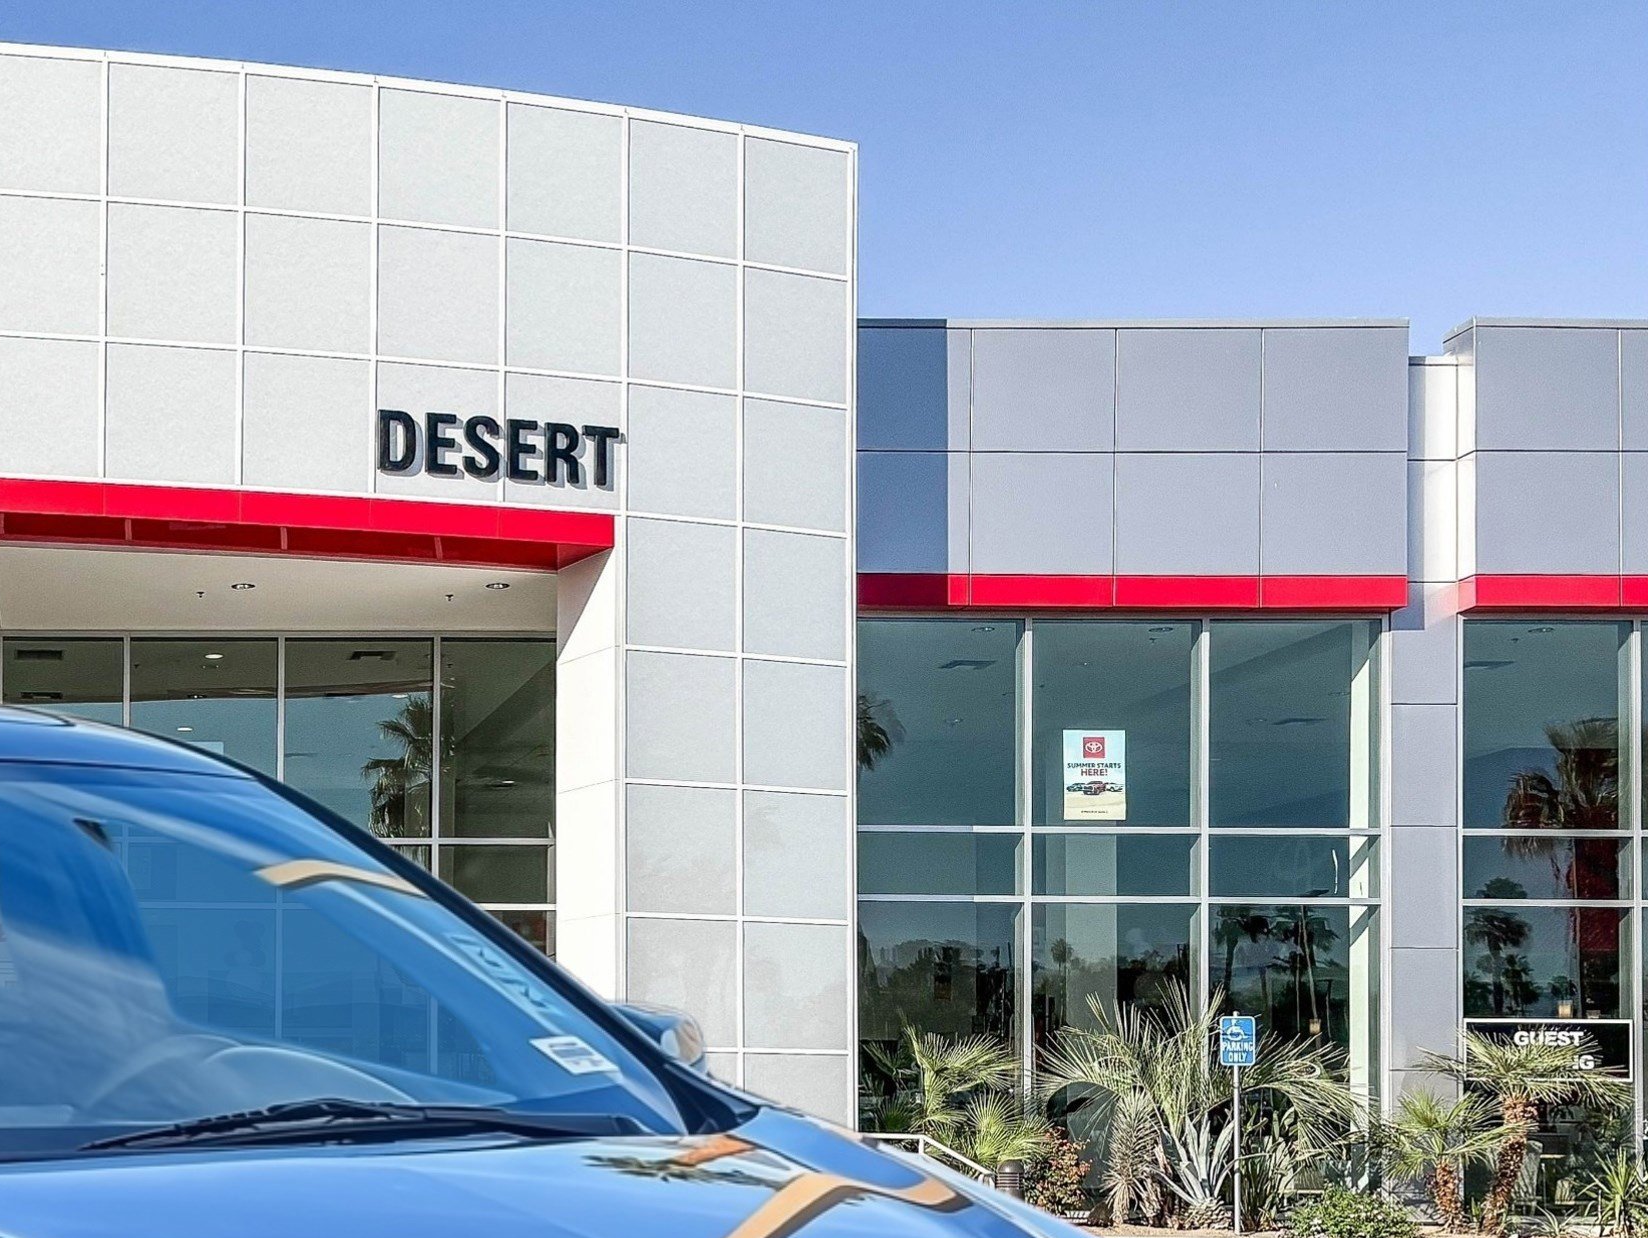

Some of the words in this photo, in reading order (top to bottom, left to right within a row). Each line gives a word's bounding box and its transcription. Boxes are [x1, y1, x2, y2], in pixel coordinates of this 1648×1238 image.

[377, 409, 621, 487] DESERT
[1513, 1031, 1584, 1046] GUEST
[1222, 1041, 1254, 1052] PARKING
[1228, 1052, 1248, 1063] ONLY
